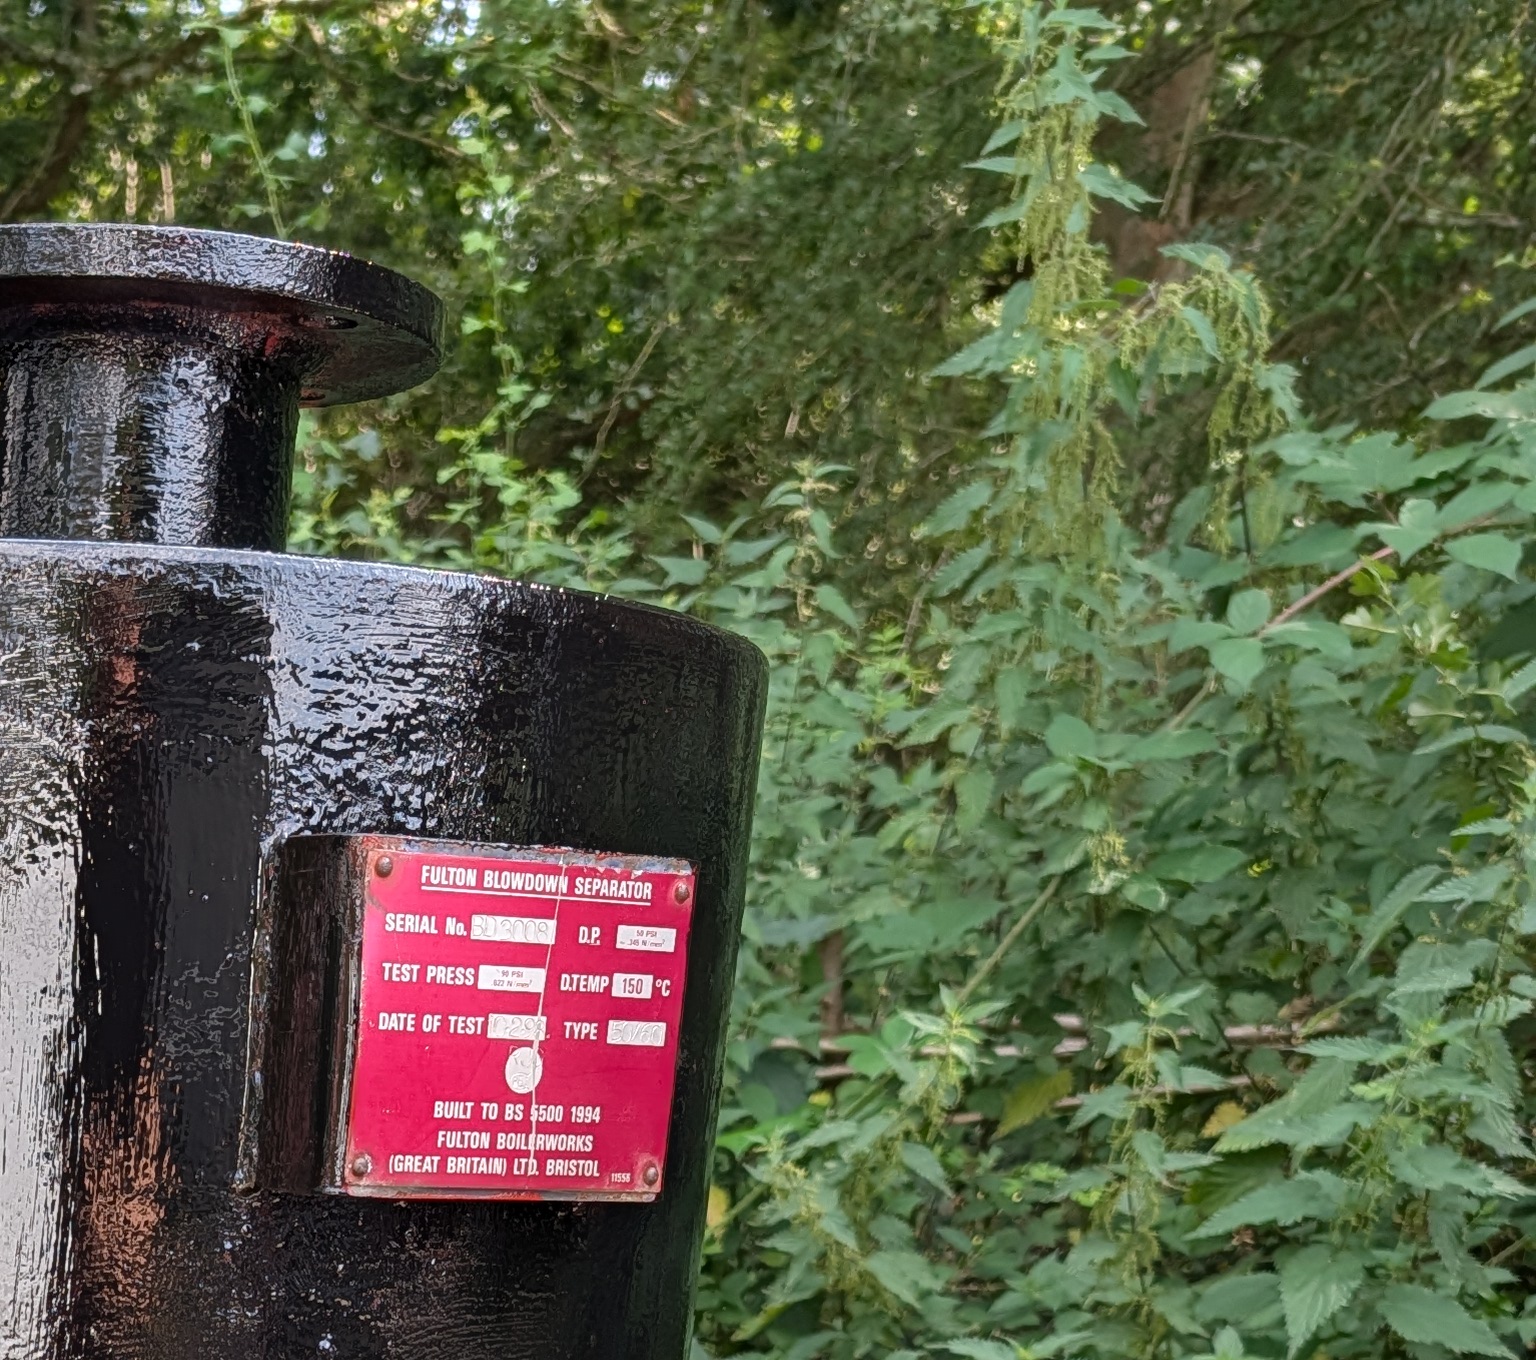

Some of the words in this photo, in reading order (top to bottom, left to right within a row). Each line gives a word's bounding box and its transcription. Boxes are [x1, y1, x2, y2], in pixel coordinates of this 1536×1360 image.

[420, 865, 477, 887] FULTON
[483, 870, 568, 894] BLOWDOWN
[574, 877, 652, 900] SEPARATOR
[385, 913, 438, 934] SERIAL
[445, 917, 467, 936] No.
[578, 926, 601, 945] D.P.
[382, 962, 421, 982] TEST
[426, 965, 476, 986] PRESS
[560, 973, 610, 993] D.TEMP
[622, 978, 644, 995] 150
[378, 1012, 416, 1032] DATE
[422, 1014, 442, 1033] OF
[448, 1016, 485, 1035] TEST
[563, 1021, 599, 1040] TYPE
[433, 1100, 474, 1119] BUILT
[480, 1102, 499, 1120] TO
[504, 1103, 524, 1121] BS
[530, 1104, 564, 1122] 5500
[570, 1105, 601, 1123] 1994
[437, 1130, 491, 1149] FULTON
[496, 1132, 594, 1152] BOILERWORKS
[389, 1154, 441, 1174] (GREAT
[446, 1156, 507, 1177] BRITAIN)
[513, 1158, 539, 1176] LTD.
[545, 1159, 600, 1177] BRISTOL
